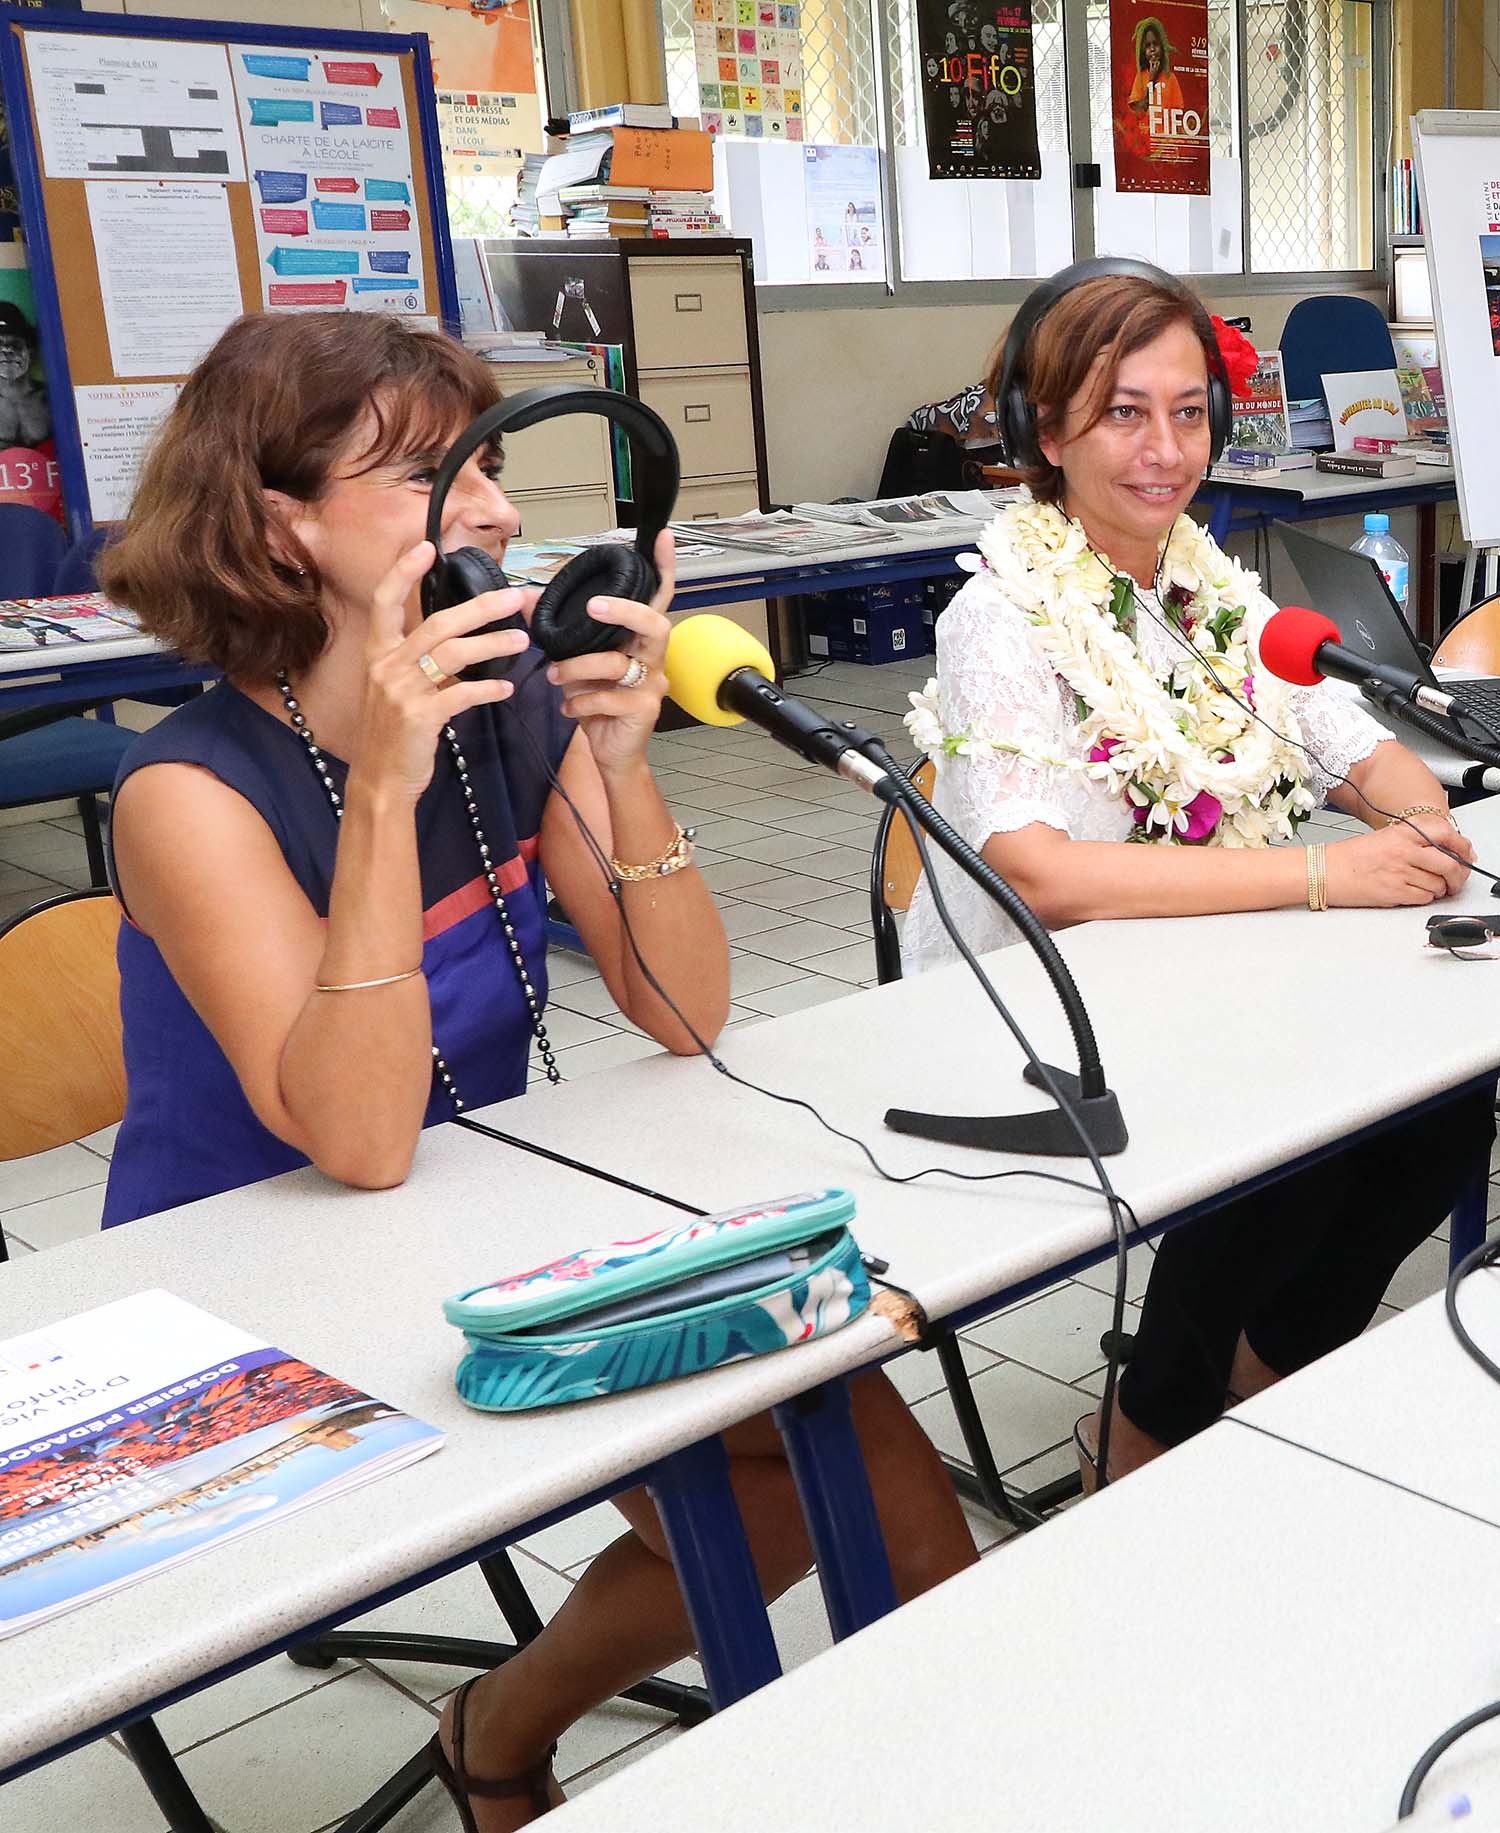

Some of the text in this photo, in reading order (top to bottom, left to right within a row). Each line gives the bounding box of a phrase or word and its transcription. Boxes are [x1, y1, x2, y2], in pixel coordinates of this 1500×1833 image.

[476, 105, 503, 115] PRESSE
[465, 116, 480, 124] DES
[481, 115, 510, 125] MÉDIAS
[1149, 105, 1201, 136] FIFO
[261, 134, 310, 146] CHARTE
[314, 136, 329, 146] DE
[334, 137, 349, 147] LA
[1491, 181, 1500, 189] DE
[1257, 400, 1281, 409] MONDE
[57, 1375, 130, 1407] D'où
[125, 1363, 240, 1415] DOSSIER
[61, 1473, 130, 1505] DANS
